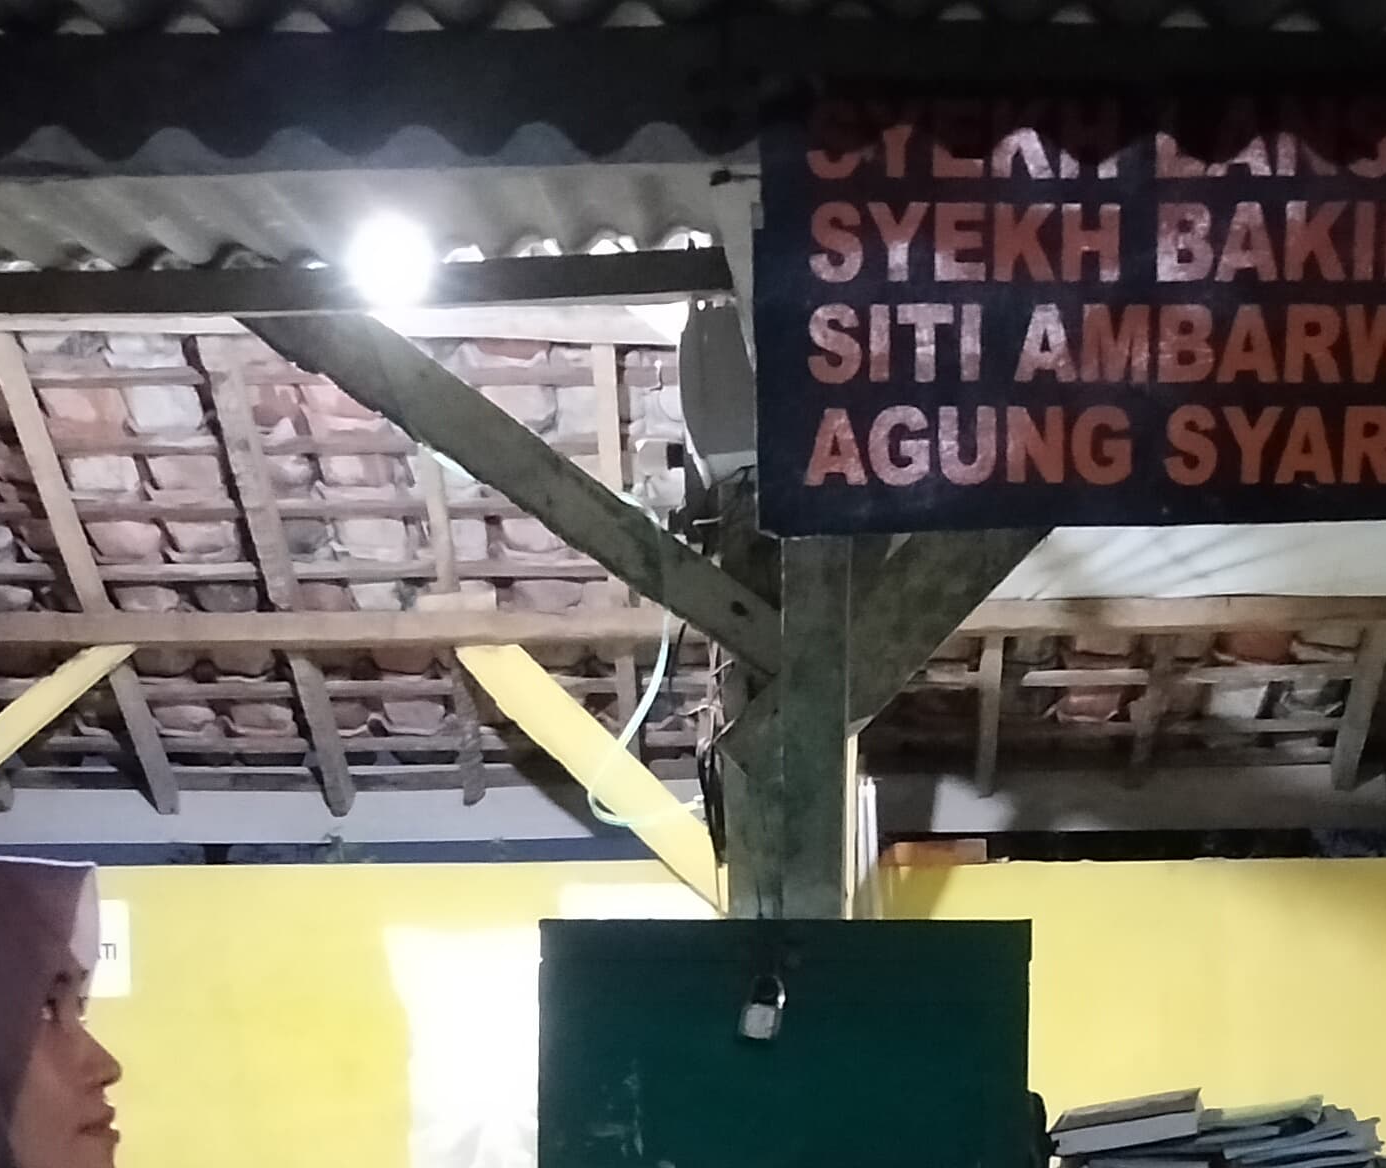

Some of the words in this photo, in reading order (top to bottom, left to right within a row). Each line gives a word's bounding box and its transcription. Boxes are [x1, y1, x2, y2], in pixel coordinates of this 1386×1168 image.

[808, 202, 1122, 283] SYEKH
[807, 303, 983, 384] SITI
[804, 406, 1134, 487] AGUNG
